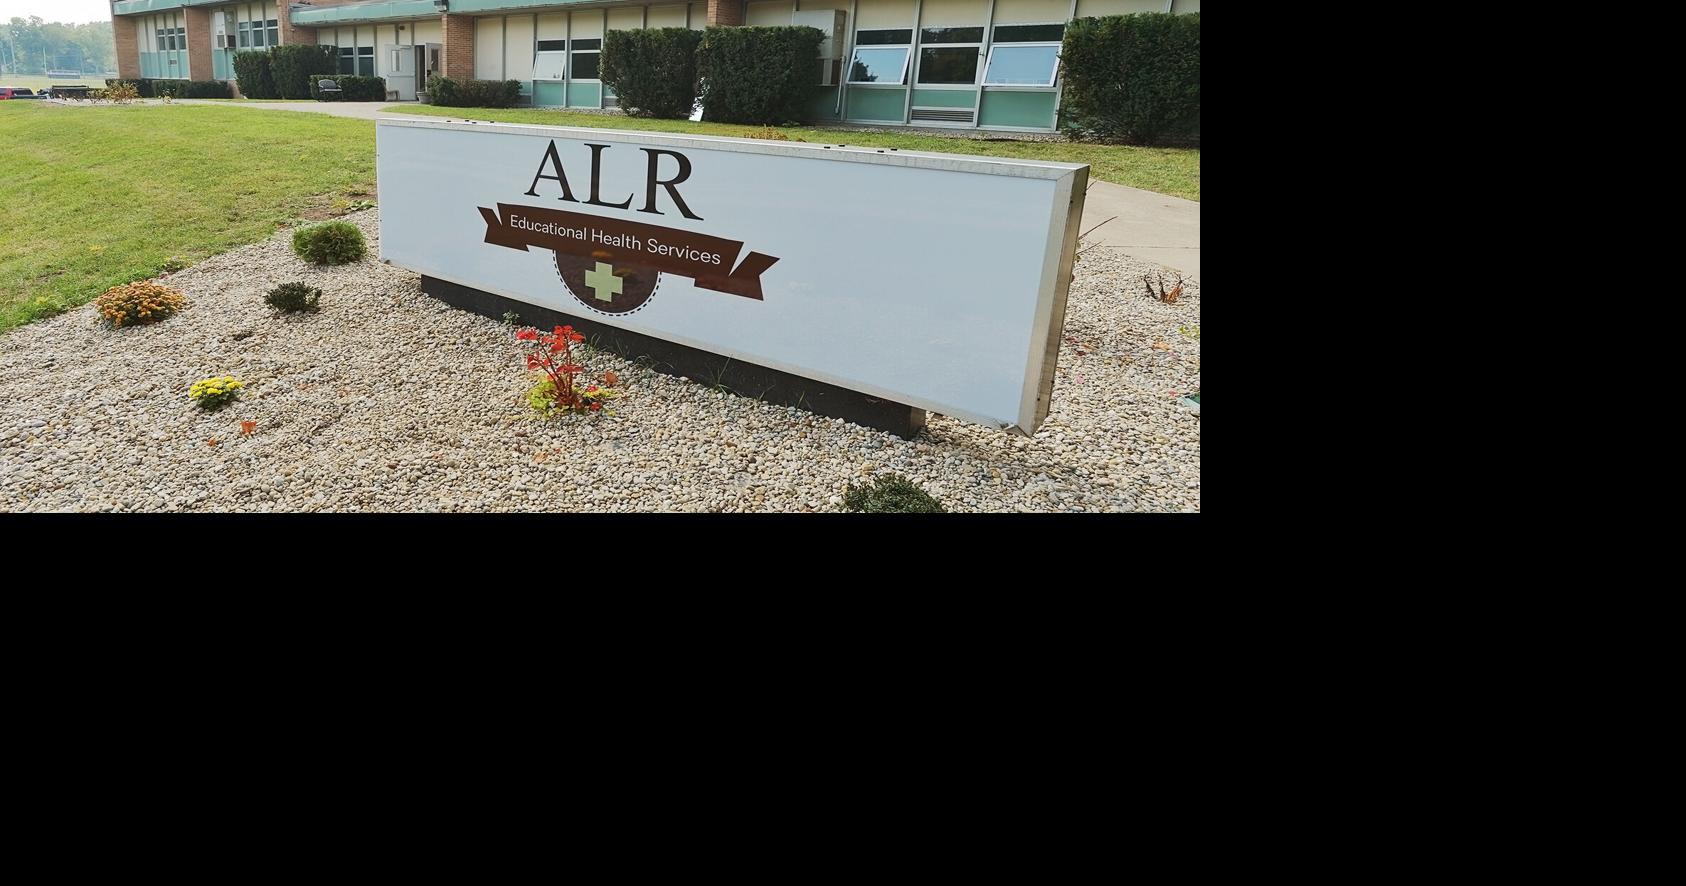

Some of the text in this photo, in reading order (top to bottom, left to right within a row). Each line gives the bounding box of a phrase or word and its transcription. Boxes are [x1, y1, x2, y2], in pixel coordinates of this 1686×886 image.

[524, 139, 704, 221] ALR
[510, 214, 721, 265] Educational Health Services
